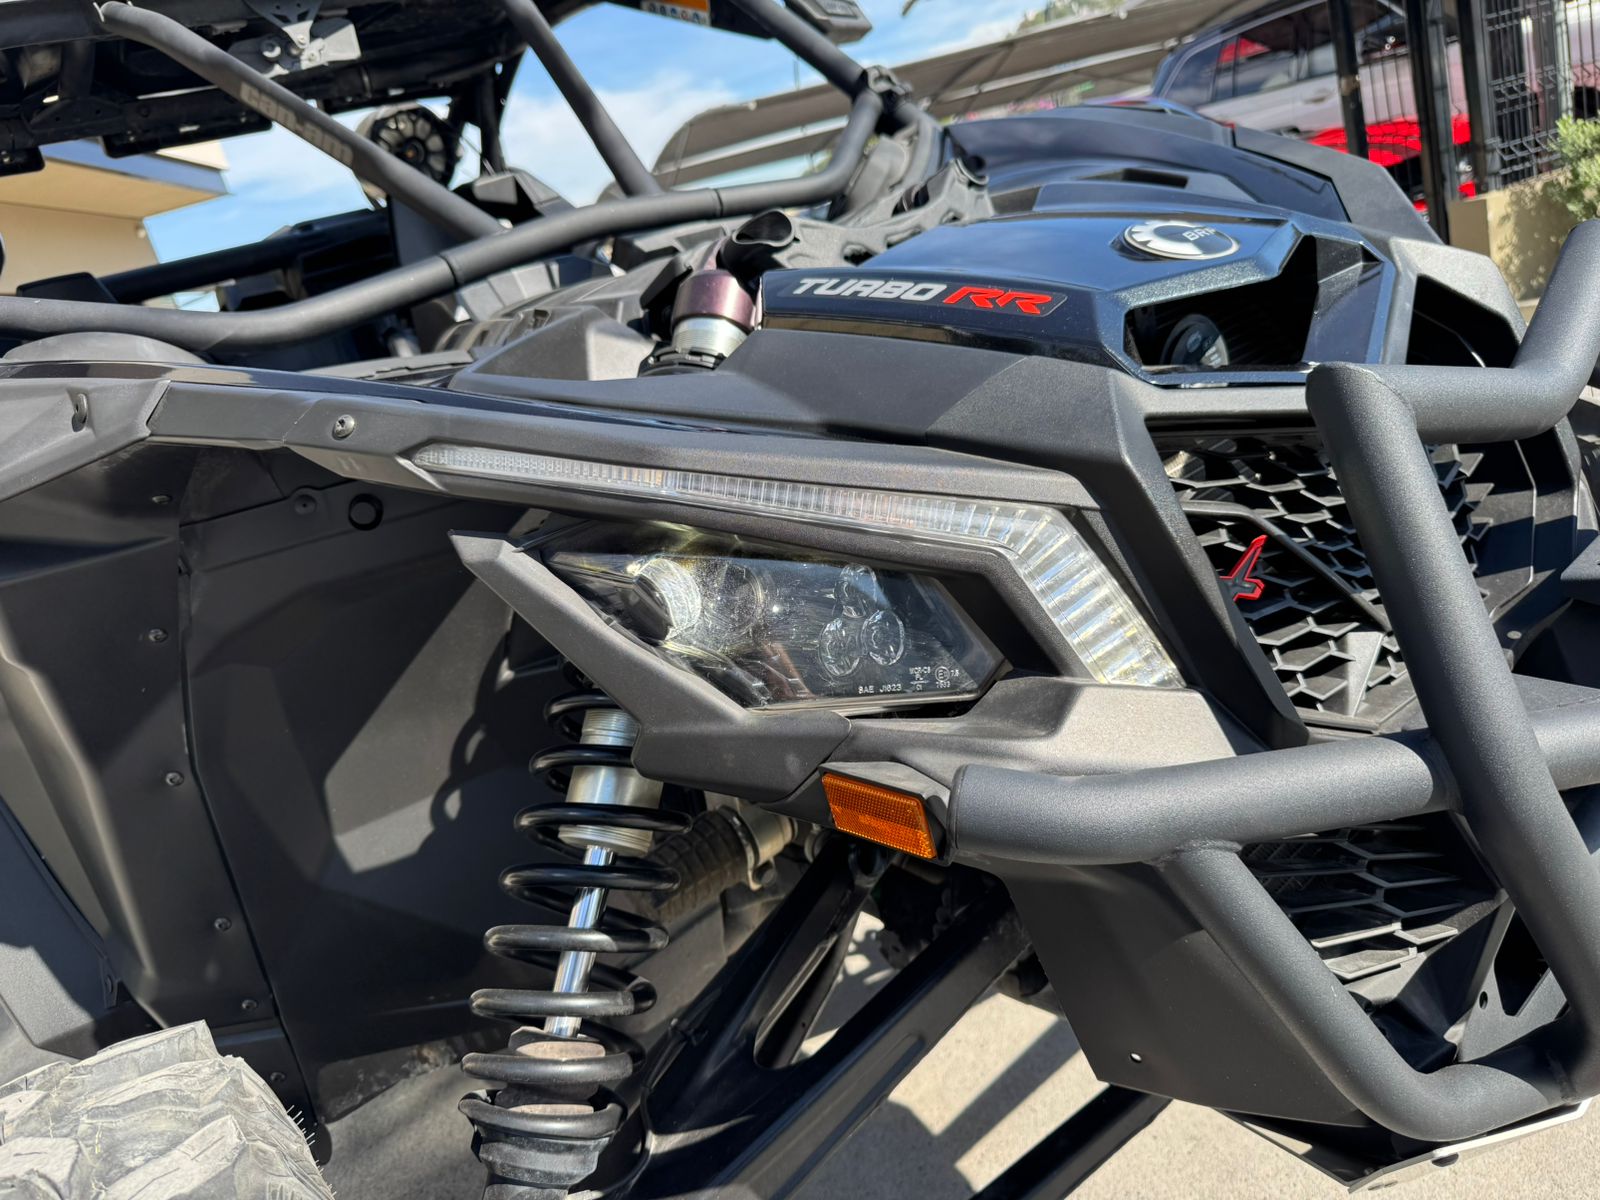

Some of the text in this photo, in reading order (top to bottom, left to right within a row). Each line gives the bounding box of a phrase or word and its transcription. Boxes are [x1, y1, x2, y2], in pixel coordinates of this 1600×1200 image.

[240, 80, 354, 168] can-am
[793, 278, 1052, 315] TURBO RR
[858, 685, 875, 694] SAE
